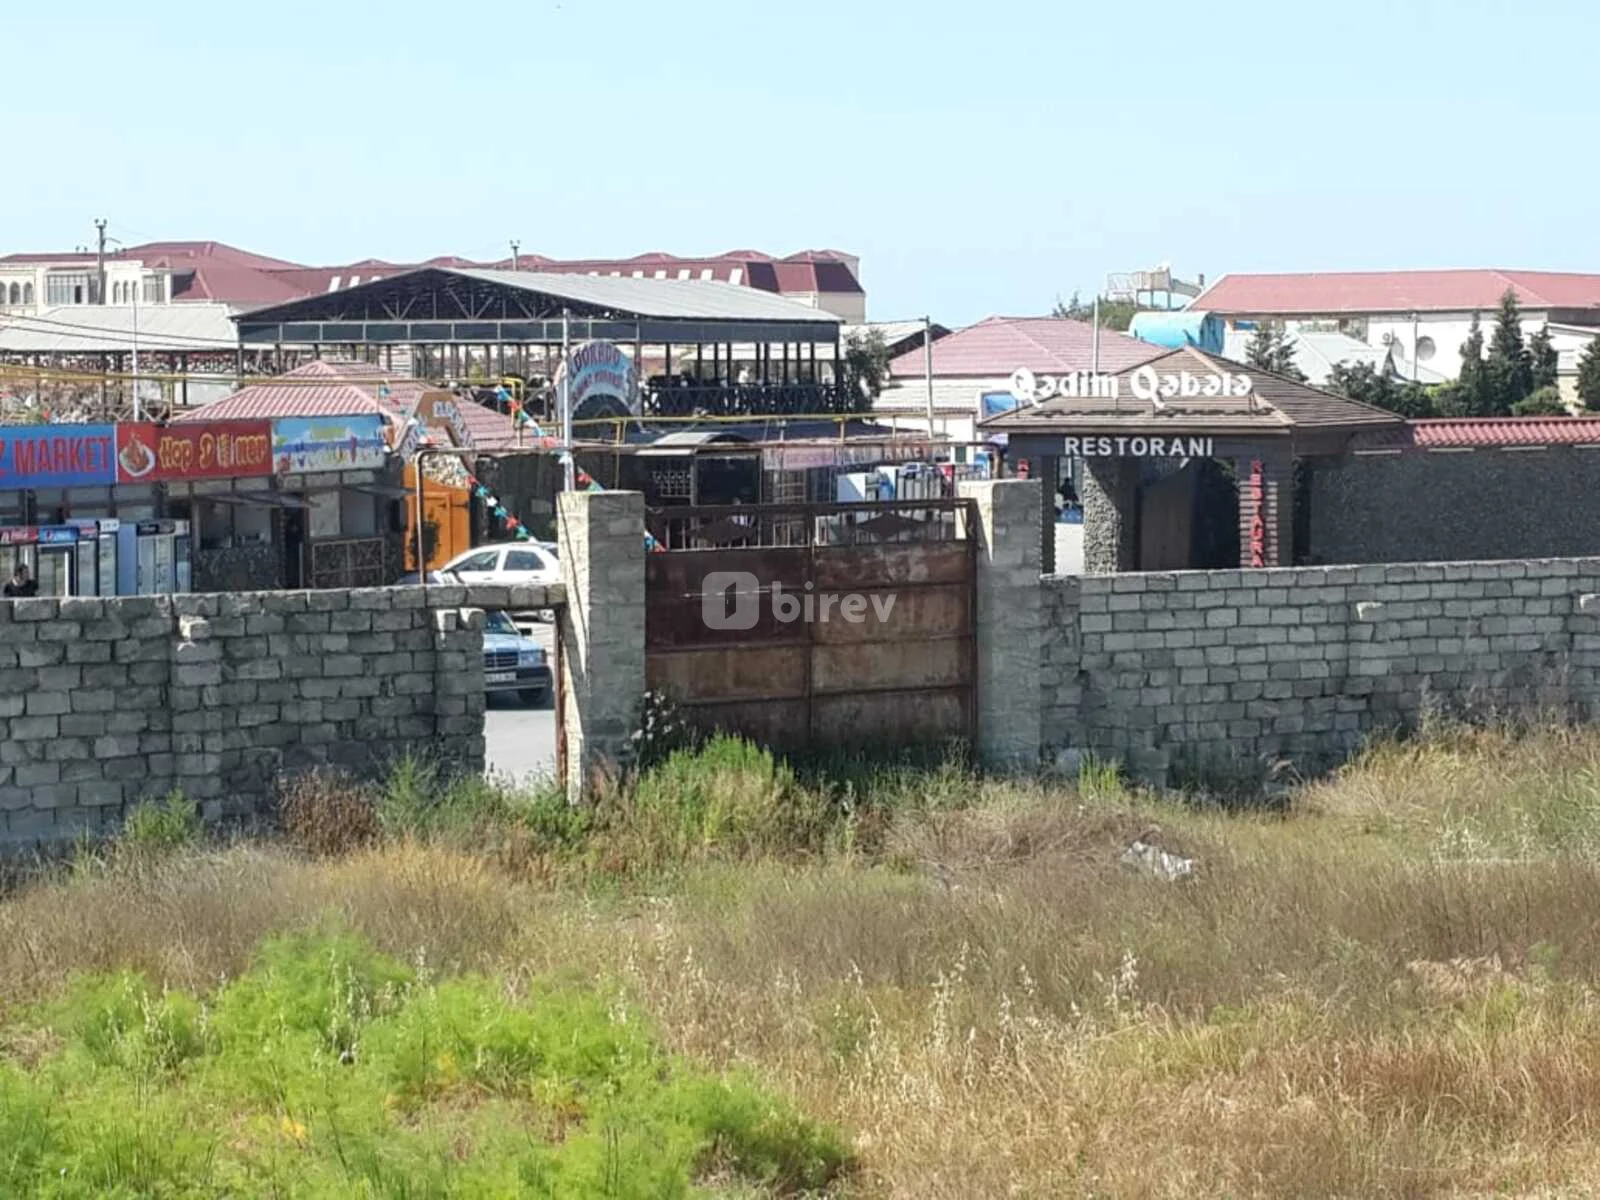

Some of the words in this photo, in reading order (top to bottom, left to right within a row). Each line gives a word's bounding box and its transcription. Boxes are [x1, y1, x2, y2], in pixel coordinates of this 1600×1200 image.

[1010, 366, 1118, 408] Qədim
[1130, 365, 1252, 408] Qəbələ
[14, 436, 111, 475] MARKET
[1064, 436, 1213, 456] RESTORANI
